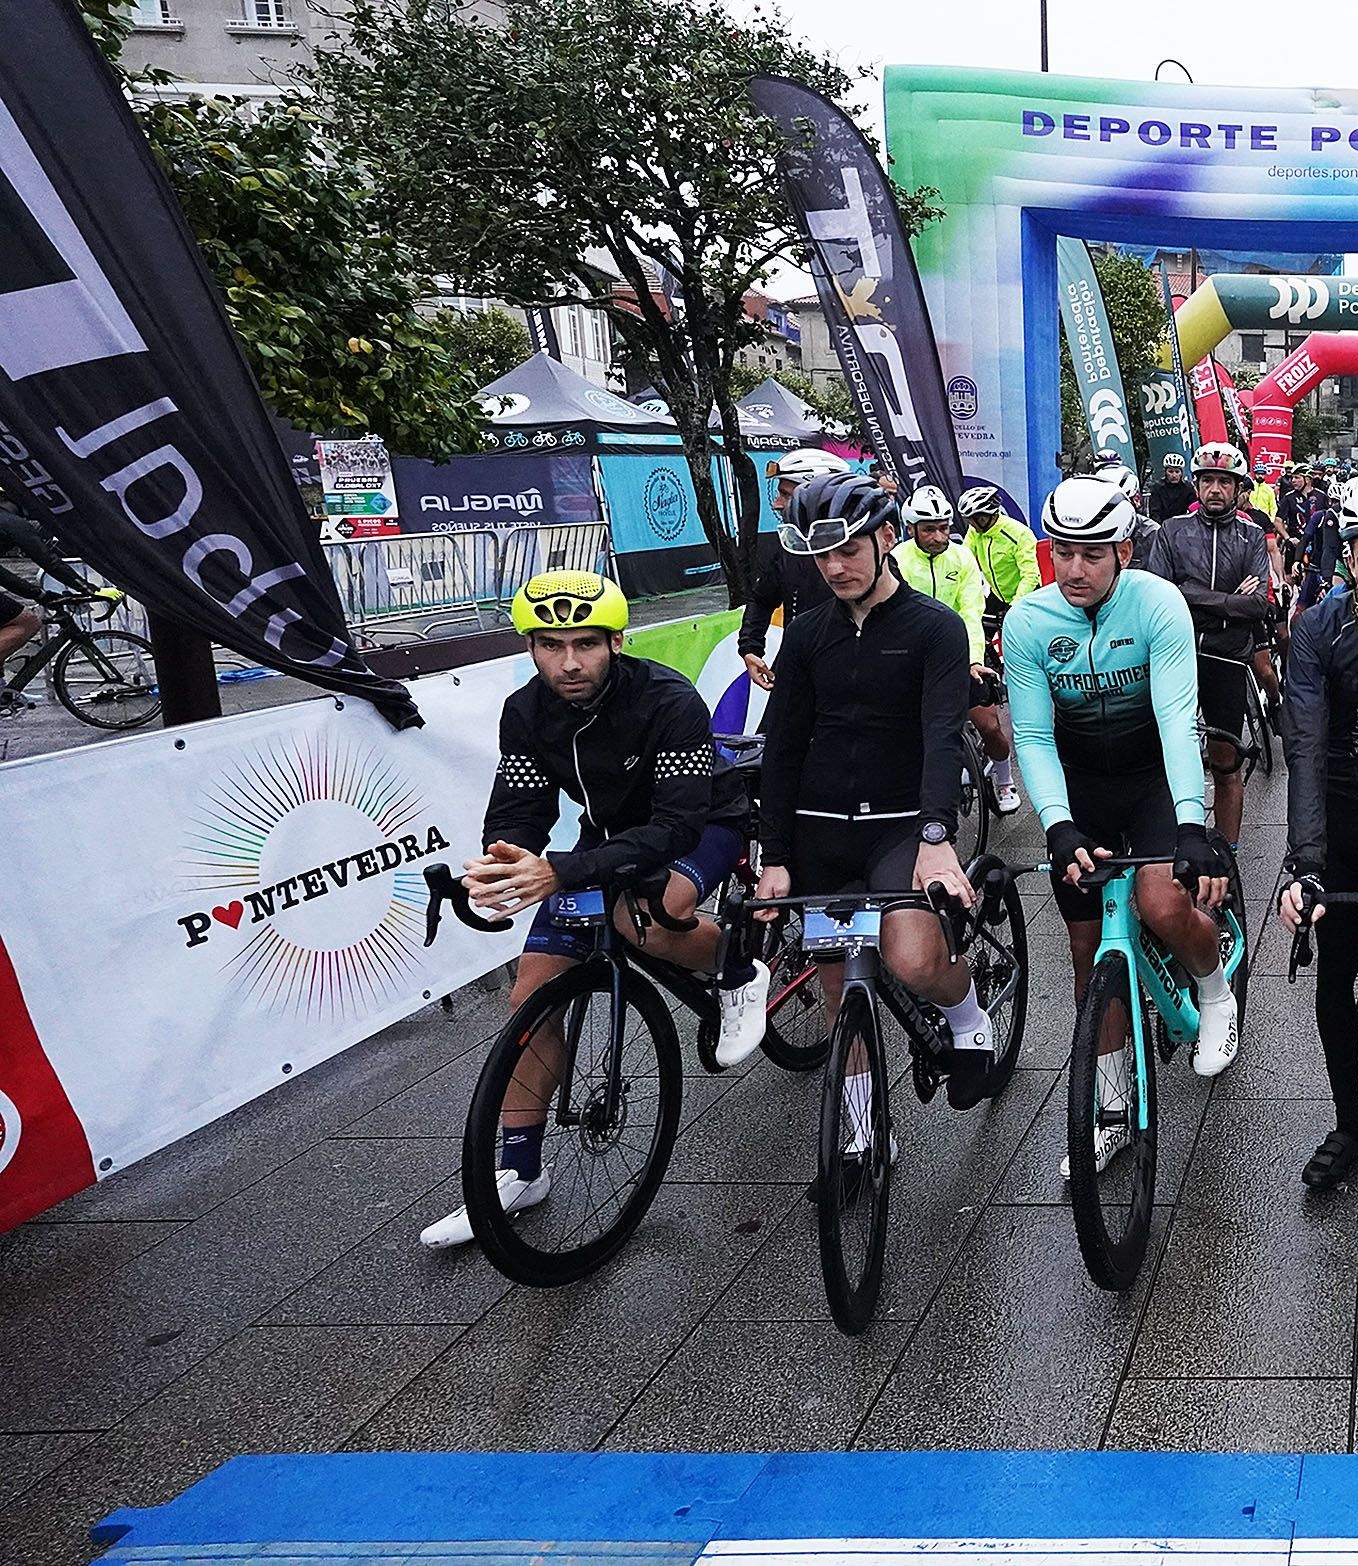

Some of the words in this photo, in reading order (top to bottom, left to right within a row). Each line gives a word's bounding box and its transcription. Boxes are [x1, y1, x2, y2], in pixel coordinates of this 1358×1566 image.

[1022, 110, 1278, 151] DEPORTE
[1276, 355, 1317, 393] FROIZ
[177, 825, 450, 948] PNTEVEDRA
[558, 897, 577, 911] 25
